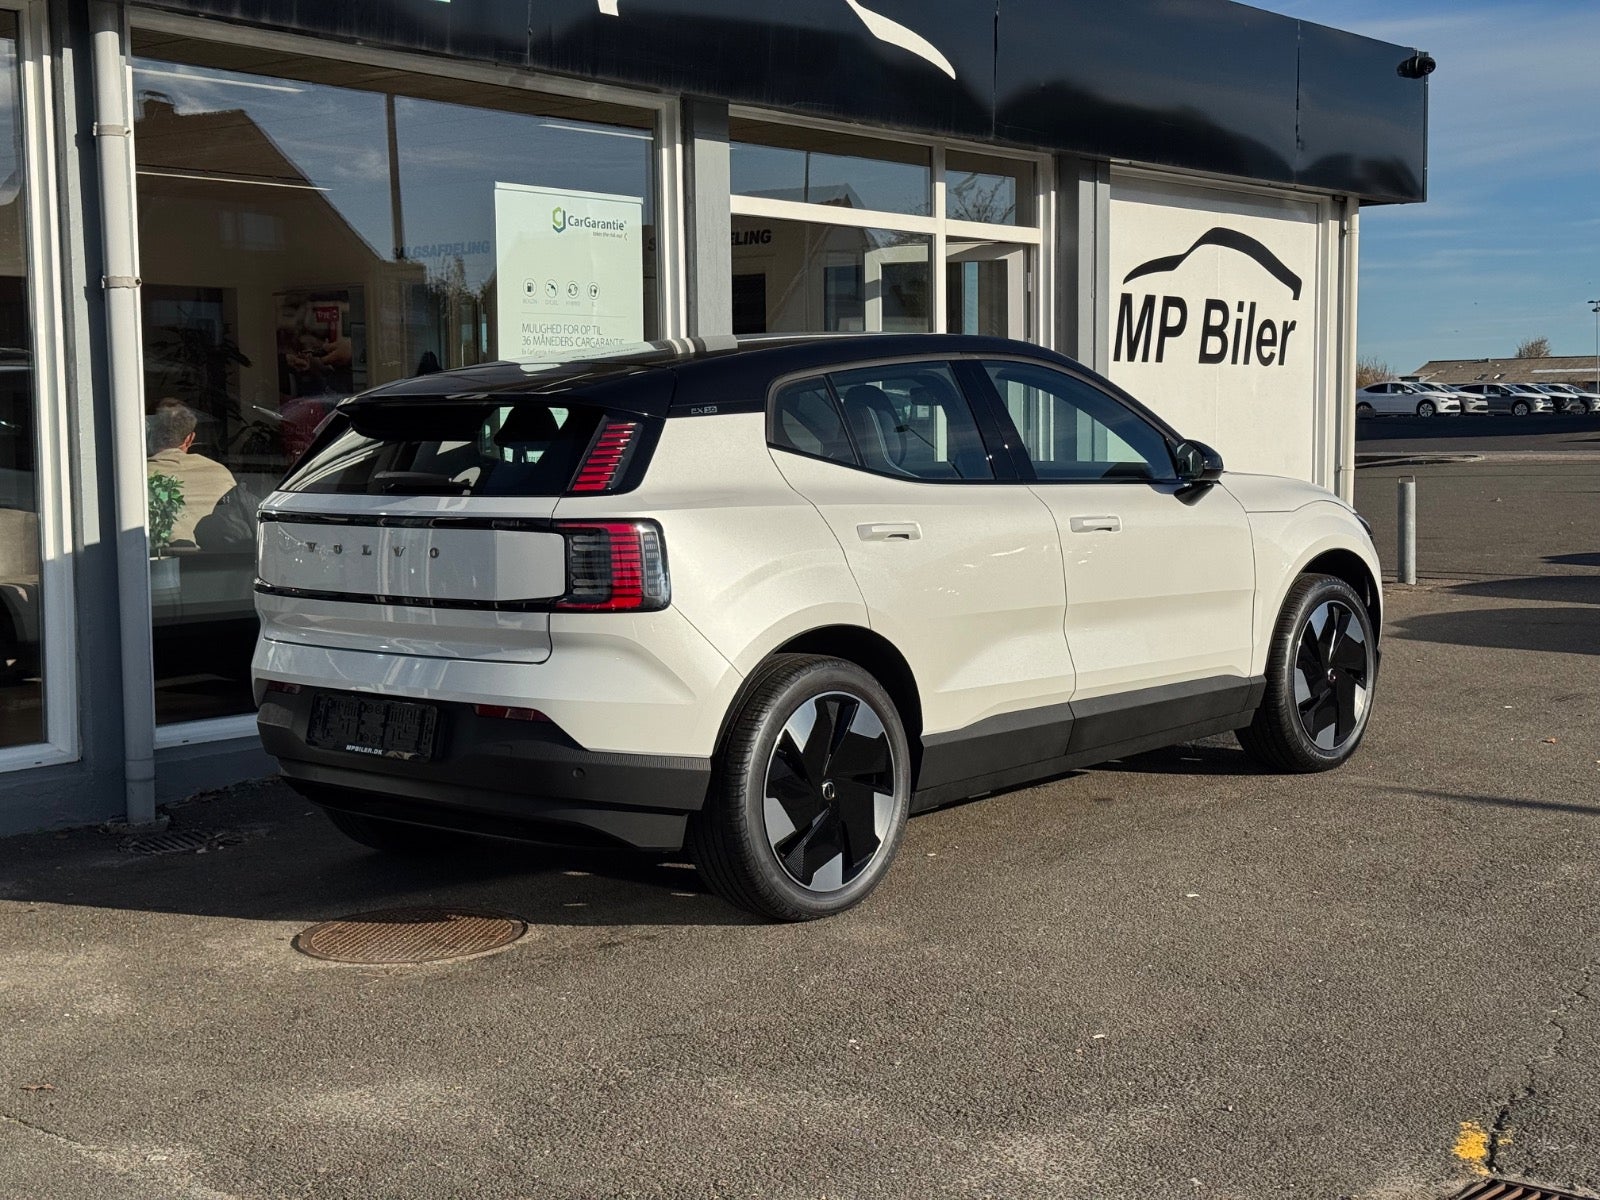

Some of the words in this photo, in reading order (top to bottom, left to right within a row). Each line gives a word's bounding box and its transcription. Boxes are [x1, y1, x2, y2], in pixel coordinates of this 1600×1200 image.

[567, 215, 625, 231] CarGarantie
[521, 323, 562, 334] MULIGHED
[563, 325, 579, 335] FOR
[580, 326, 591, 335] OP
[592, 326, 603, 335] TIL
[1113, 292, 1188, 363] MP
[1198, 298, 1297, 366] Biler
[521, 335, 532, 346] 36
[532, 334, 574, 347] MÅNEDERS
[306, 542, 440, 559] VOLVO
